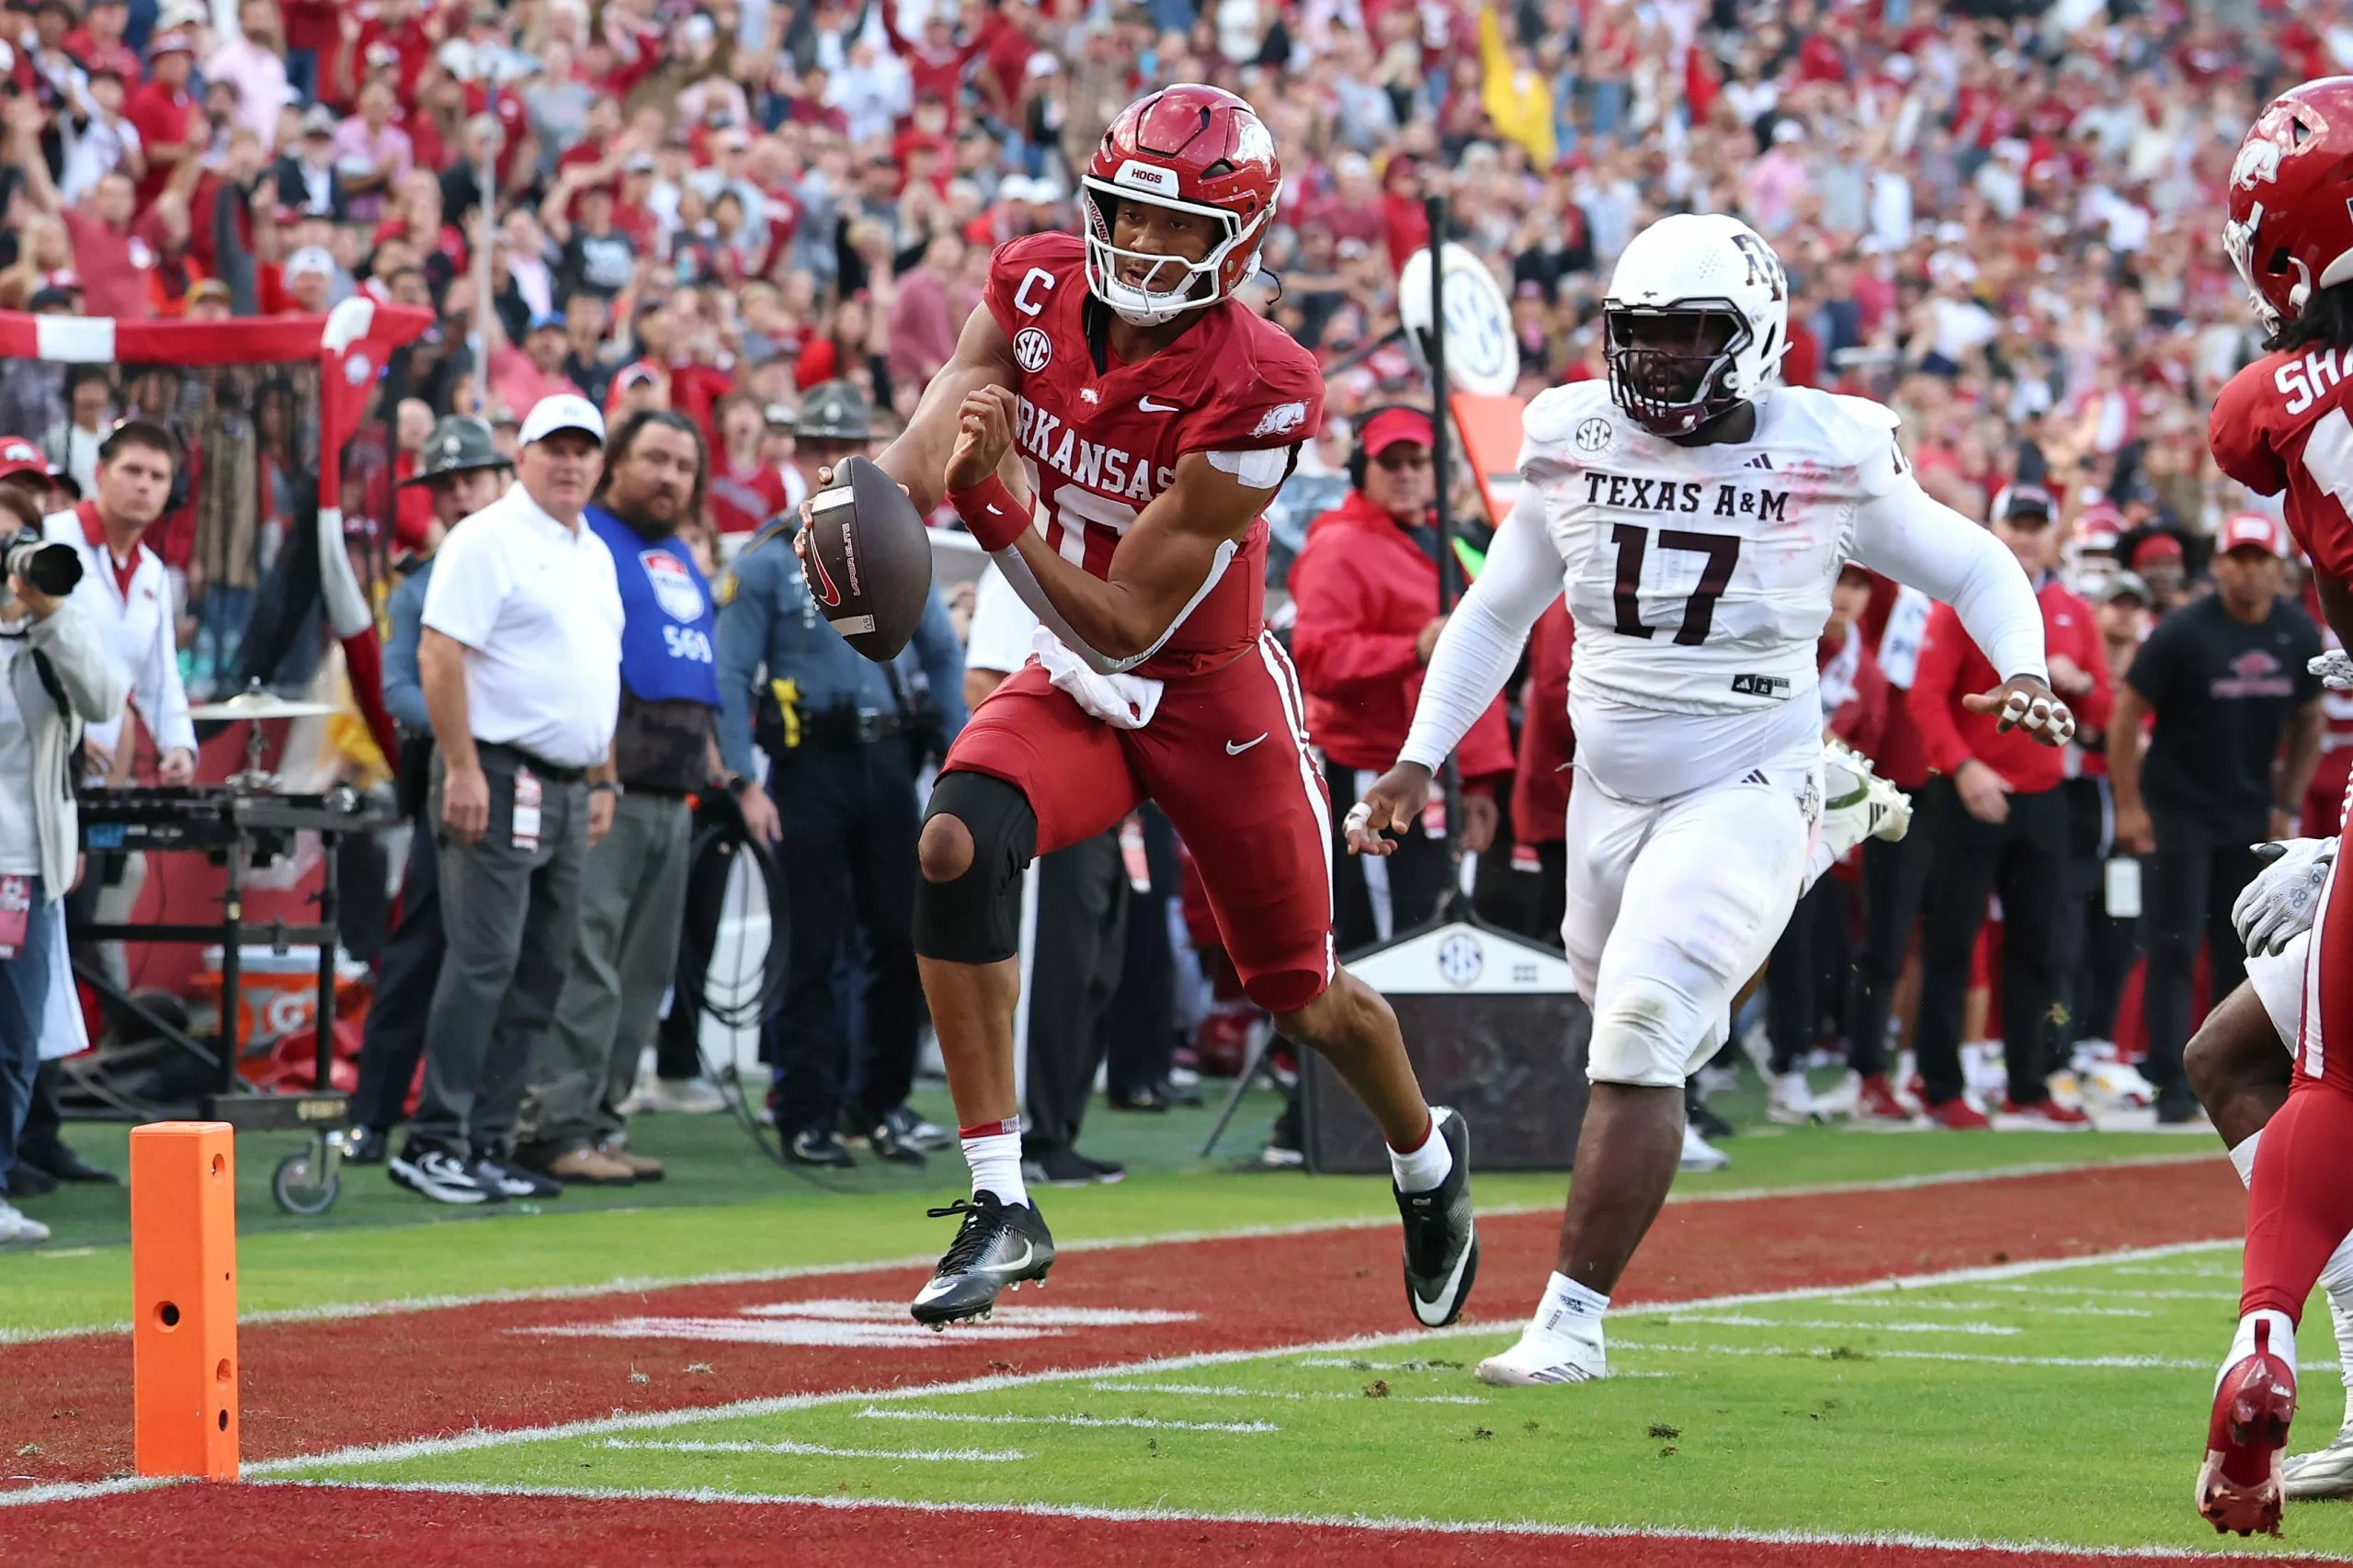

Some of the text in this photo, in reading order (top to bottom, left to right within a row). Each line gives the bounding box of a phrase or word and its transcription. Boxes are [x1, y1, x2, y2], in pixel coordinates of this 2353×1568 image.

[1131, 168, 1163, 184] HOGS
[1014, 267, 1055, 316] C
[1016, 330, 1050, 370] SEC
[1016, 393, 1176, 502] RKANSAS
[1576, 418, 1612, 451] SEC
[1585, 472, 1789, 522] TEXAS A&M
[843, 523, 860, 596] VAPOR ELITE
[1611, 522, 1741, 646] 17
